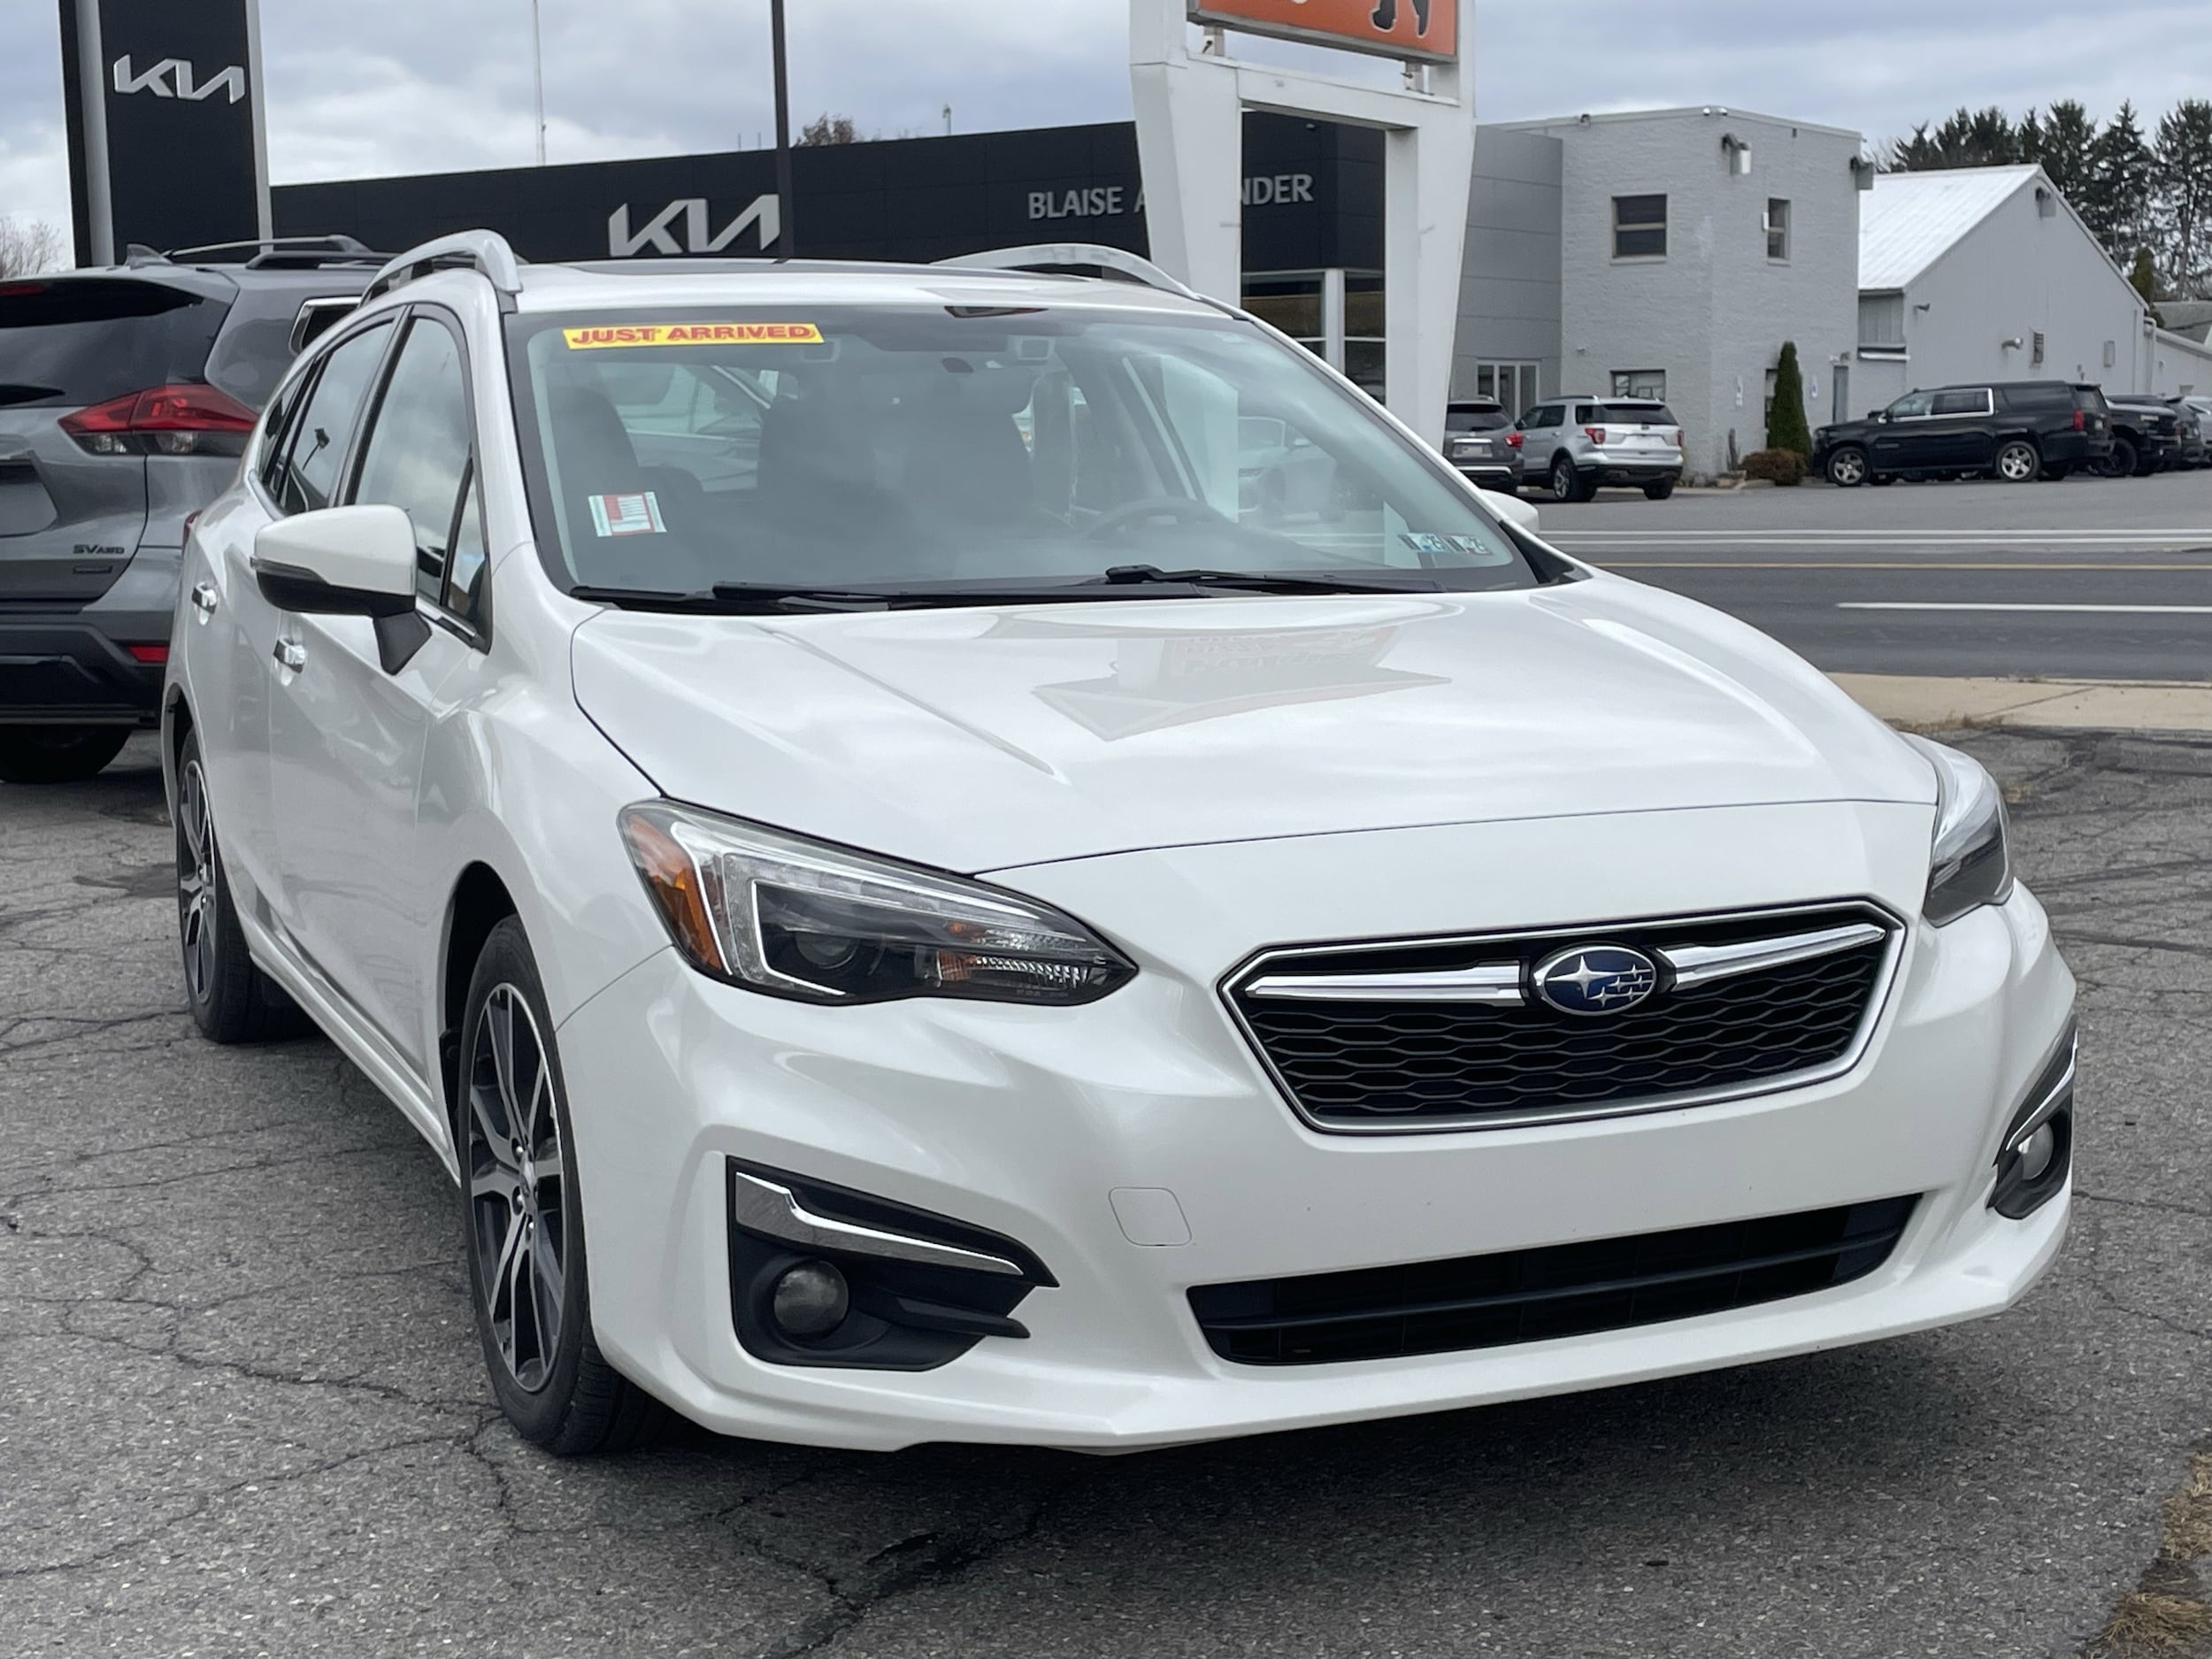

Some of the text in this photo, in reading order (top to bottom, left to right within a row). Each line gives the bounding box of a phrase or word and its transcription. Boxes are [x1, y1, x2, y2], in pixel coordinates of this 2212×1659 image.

[113, 54, 246, 104] KIA
[1028, 186, 1125, 219] BLAISE
[608, 194, 780, 257] KIA
[572, 325, 816, 344] JUST ARRIVED
